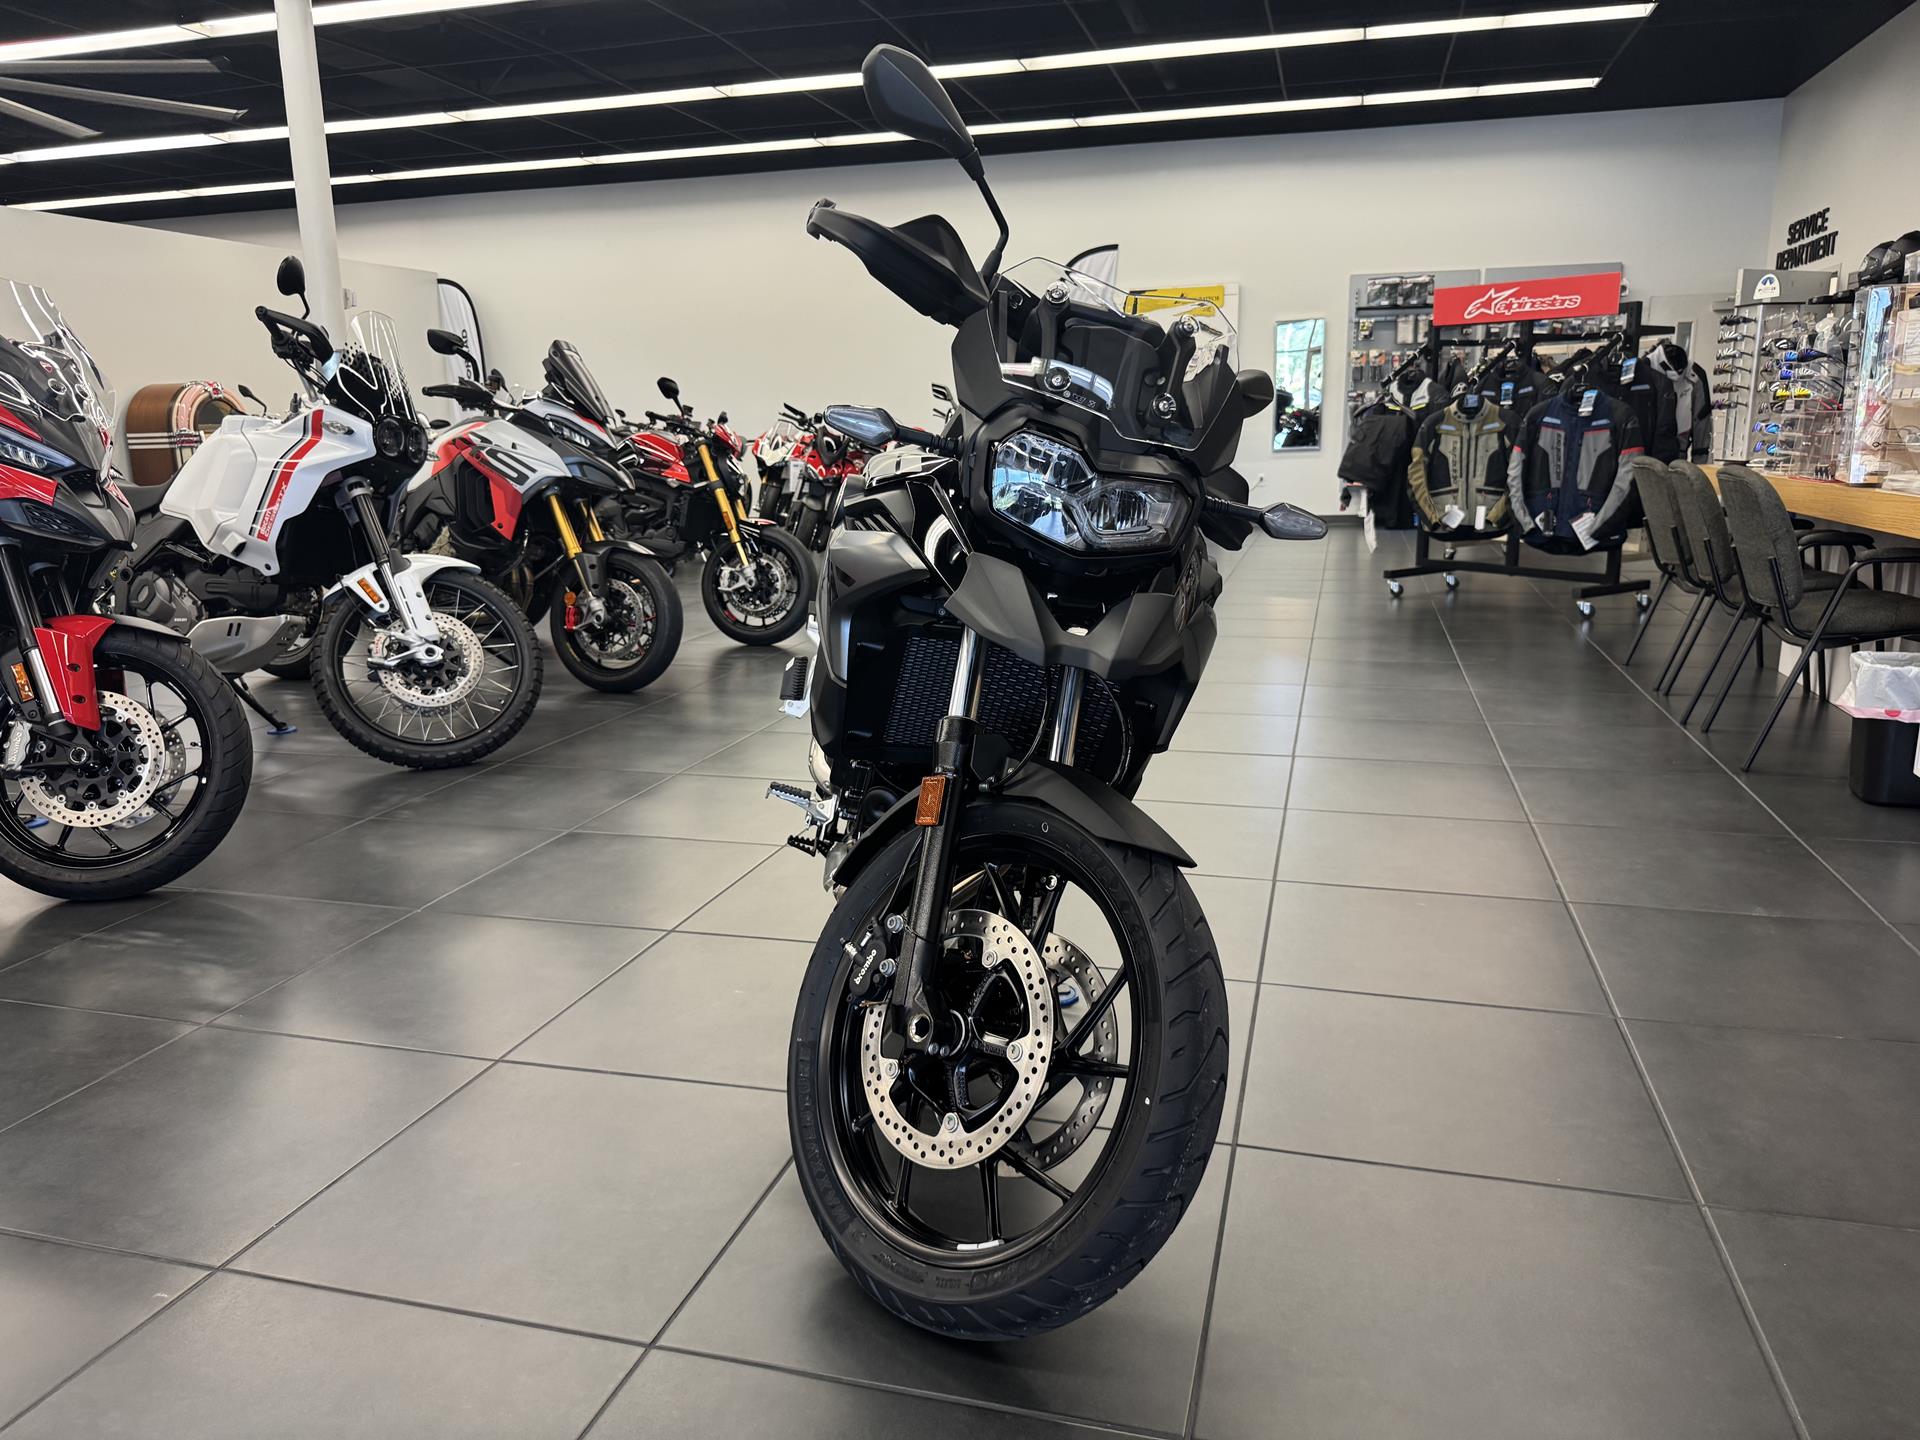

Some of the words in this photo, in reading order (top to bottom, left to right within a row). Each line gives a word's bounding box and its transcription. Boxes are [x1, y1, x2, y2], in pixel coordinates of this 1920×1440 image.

[1787, 207, 1830, 246] SERVICE
[1776, 231, 1839, 270] DEPARTMENT
[853, 949, 877, 985] brembo
